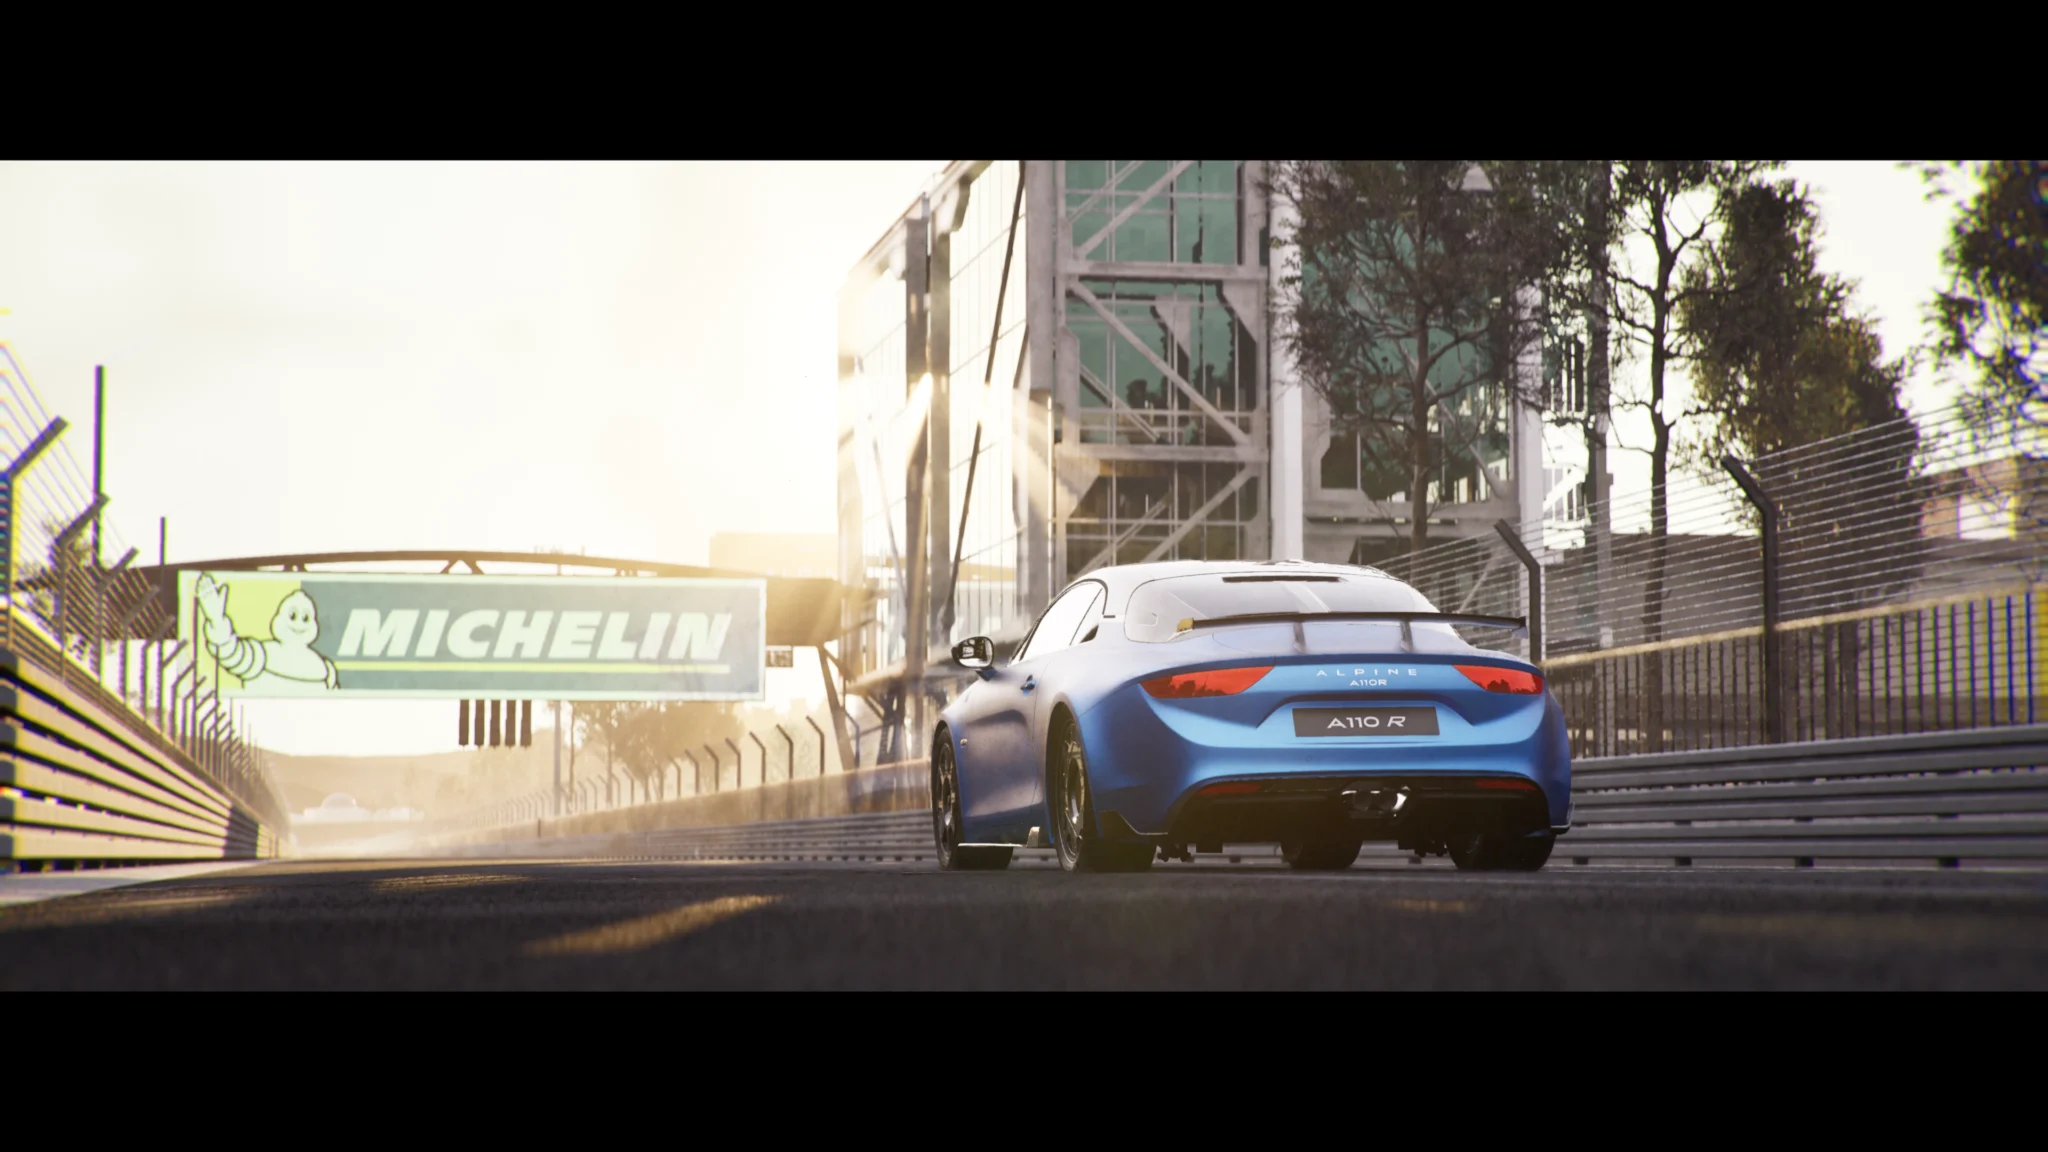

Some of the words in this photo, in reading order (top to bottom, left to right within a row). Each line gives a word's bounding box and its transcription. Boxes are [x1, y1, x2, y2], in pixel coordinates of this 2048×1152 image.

[337, 609, 732, 660] MICHELIN
[1316, 668, 1417, 677] ALPINE
[1349, 678, 1388, 687] A110R
[1327, 716, 1380, 729] A110
[1386, 716, 1406, 728] R
